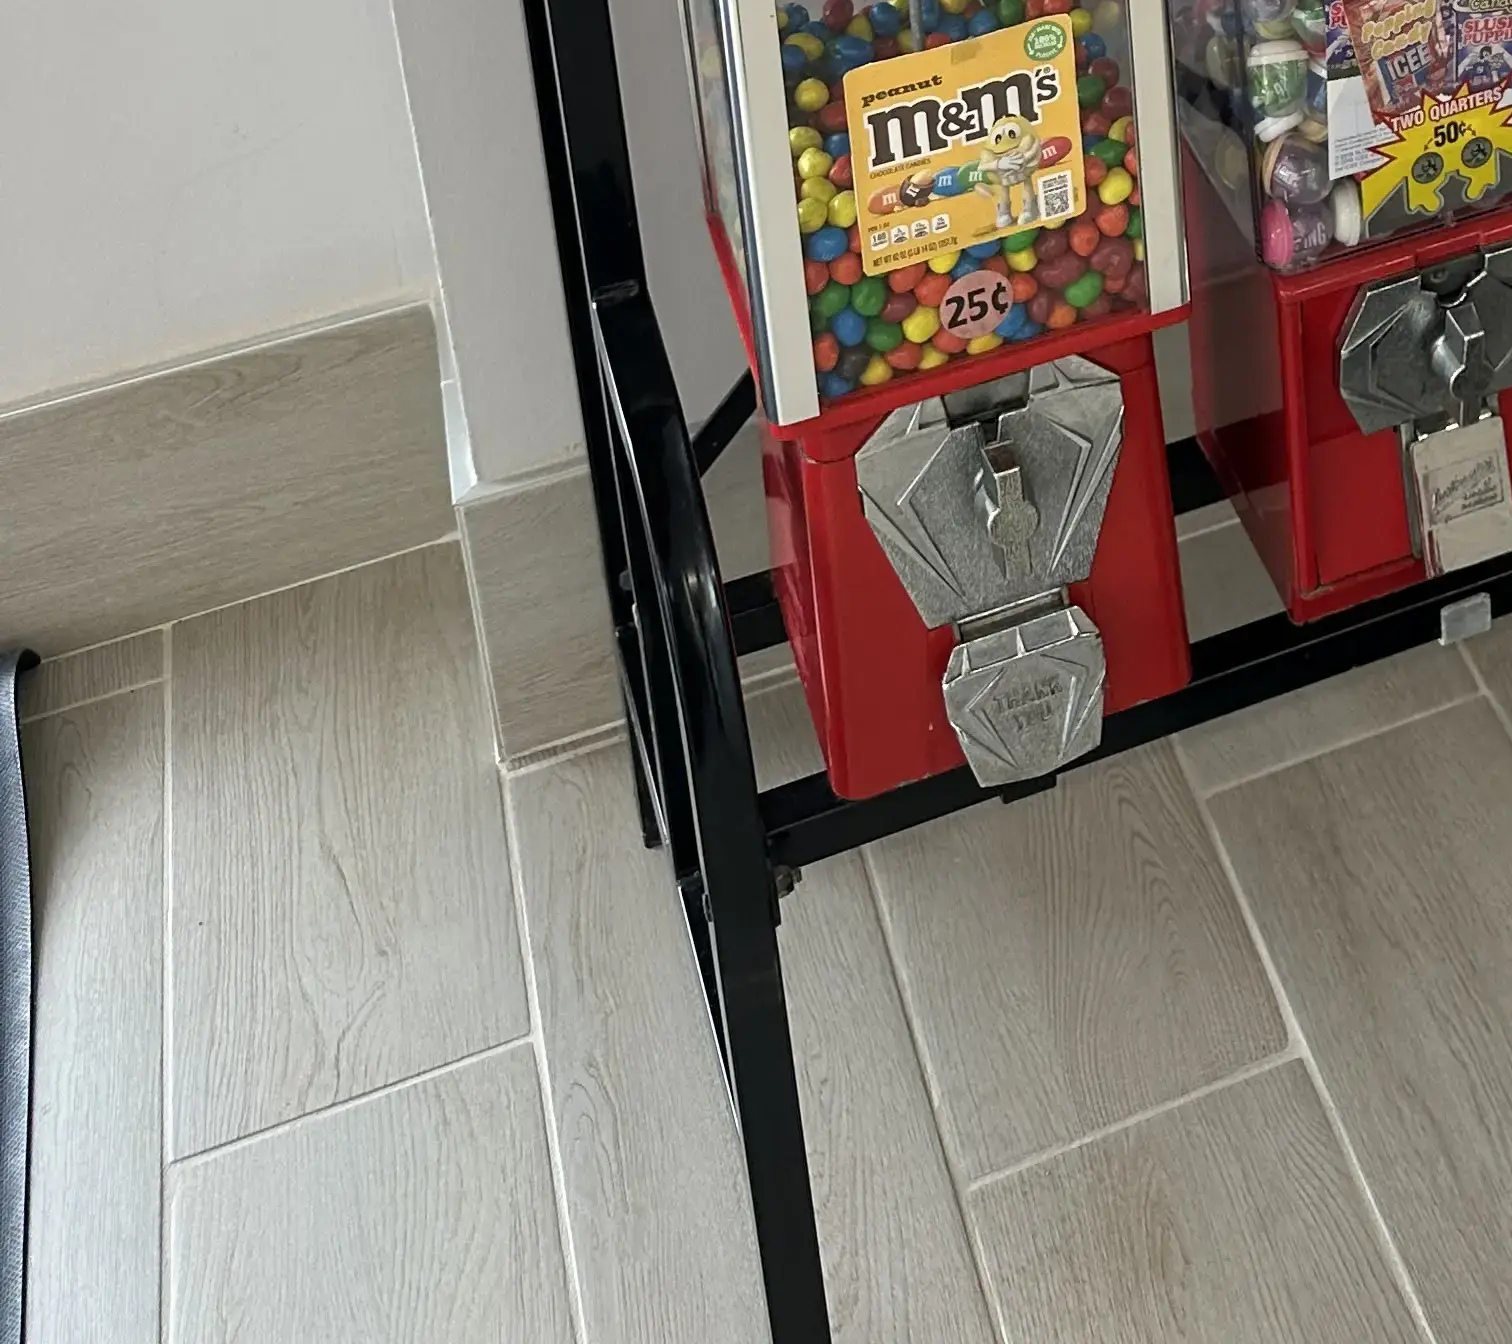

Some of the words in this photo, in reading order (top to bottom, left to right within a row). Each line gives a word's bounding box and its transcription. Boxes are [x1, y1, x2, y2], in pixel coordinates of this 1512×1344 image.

[1387, 44, 1432, 78] ICEE
[861, 74, 943, 108] peanut
[1391, 111, 1425, 132] TWO
[1429, 87, 1502, 121] QUARTERS
[1434, 120, 1467, 147] 50¢
[945, 281, 1009, 329] 25¢
